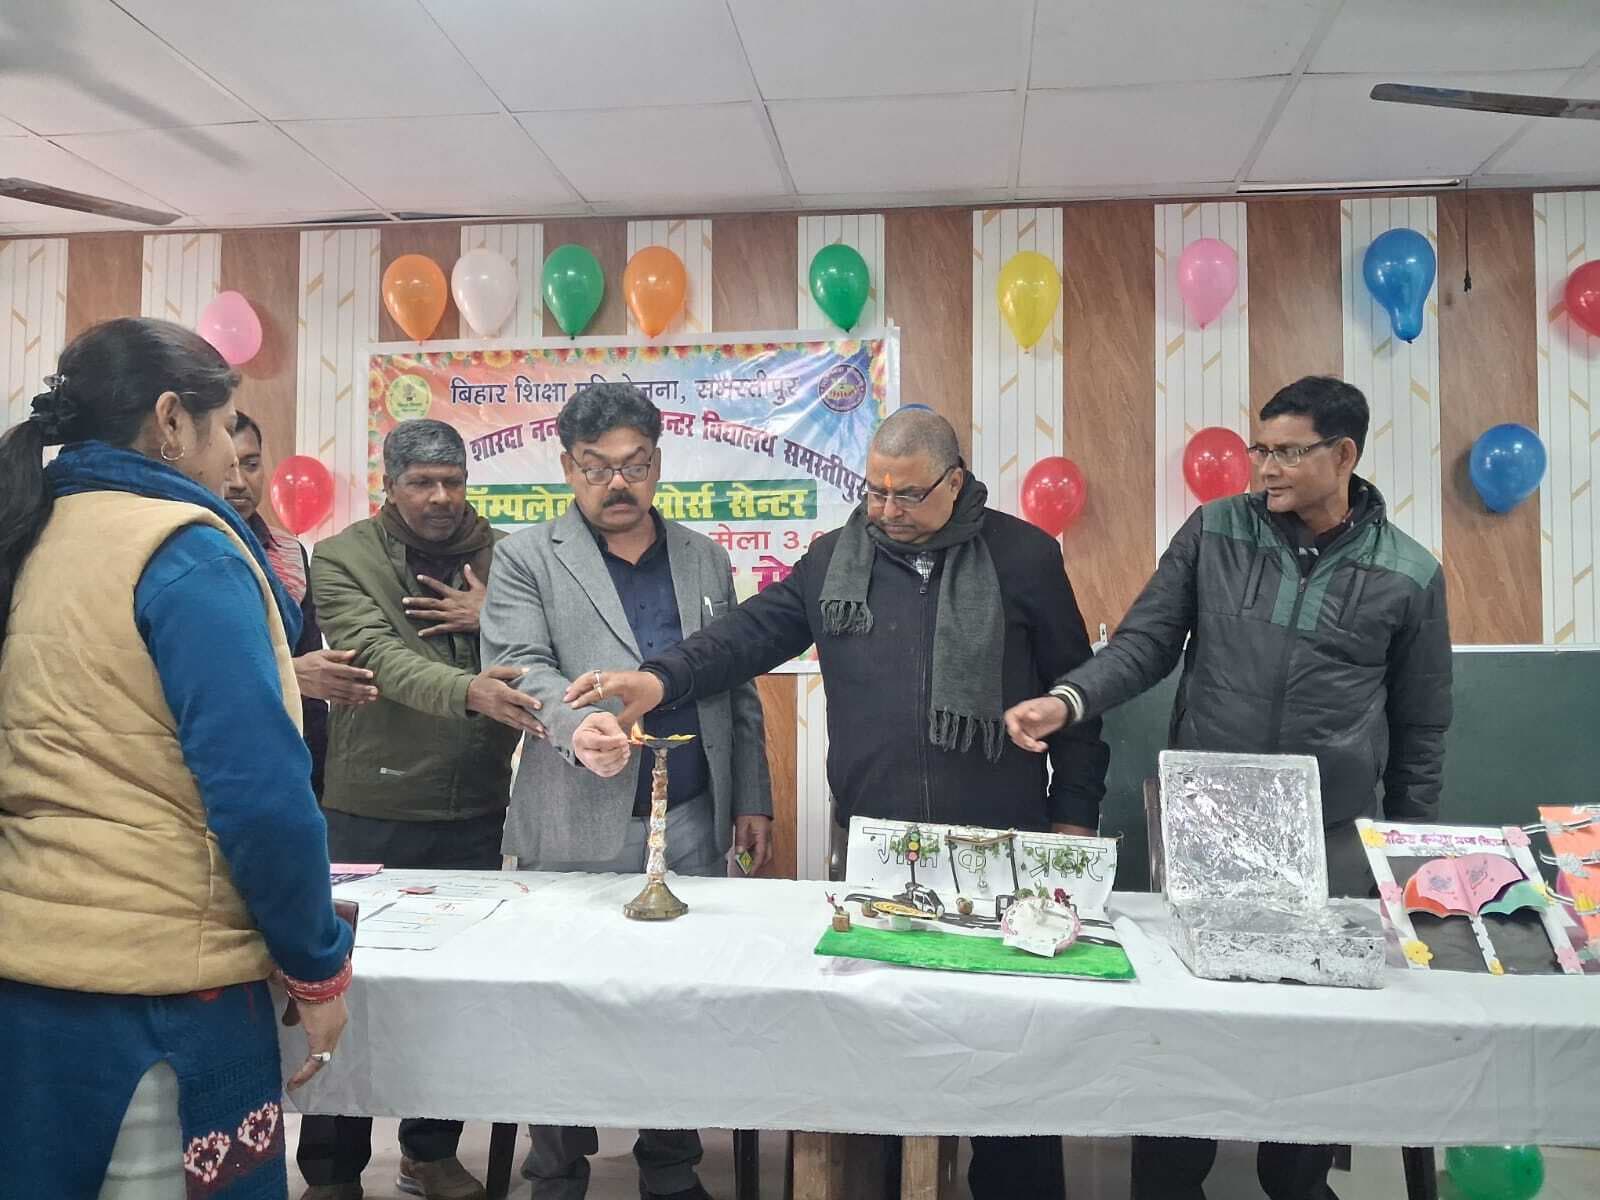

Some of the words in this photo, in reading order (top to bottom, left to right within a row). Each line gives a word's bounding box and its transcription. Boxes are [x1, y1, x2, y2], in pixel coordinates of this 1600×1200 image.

[450, 375, 508, 404] बिहार
[515, 375, 568, 402] शिक्षा
[695, 369, 800, 405] समस्तीपुर
[469, 424, 524, 461] शारदा
[726, 482, 808, 519] सेन्टर
[708, 523, 771, 550] मेला
